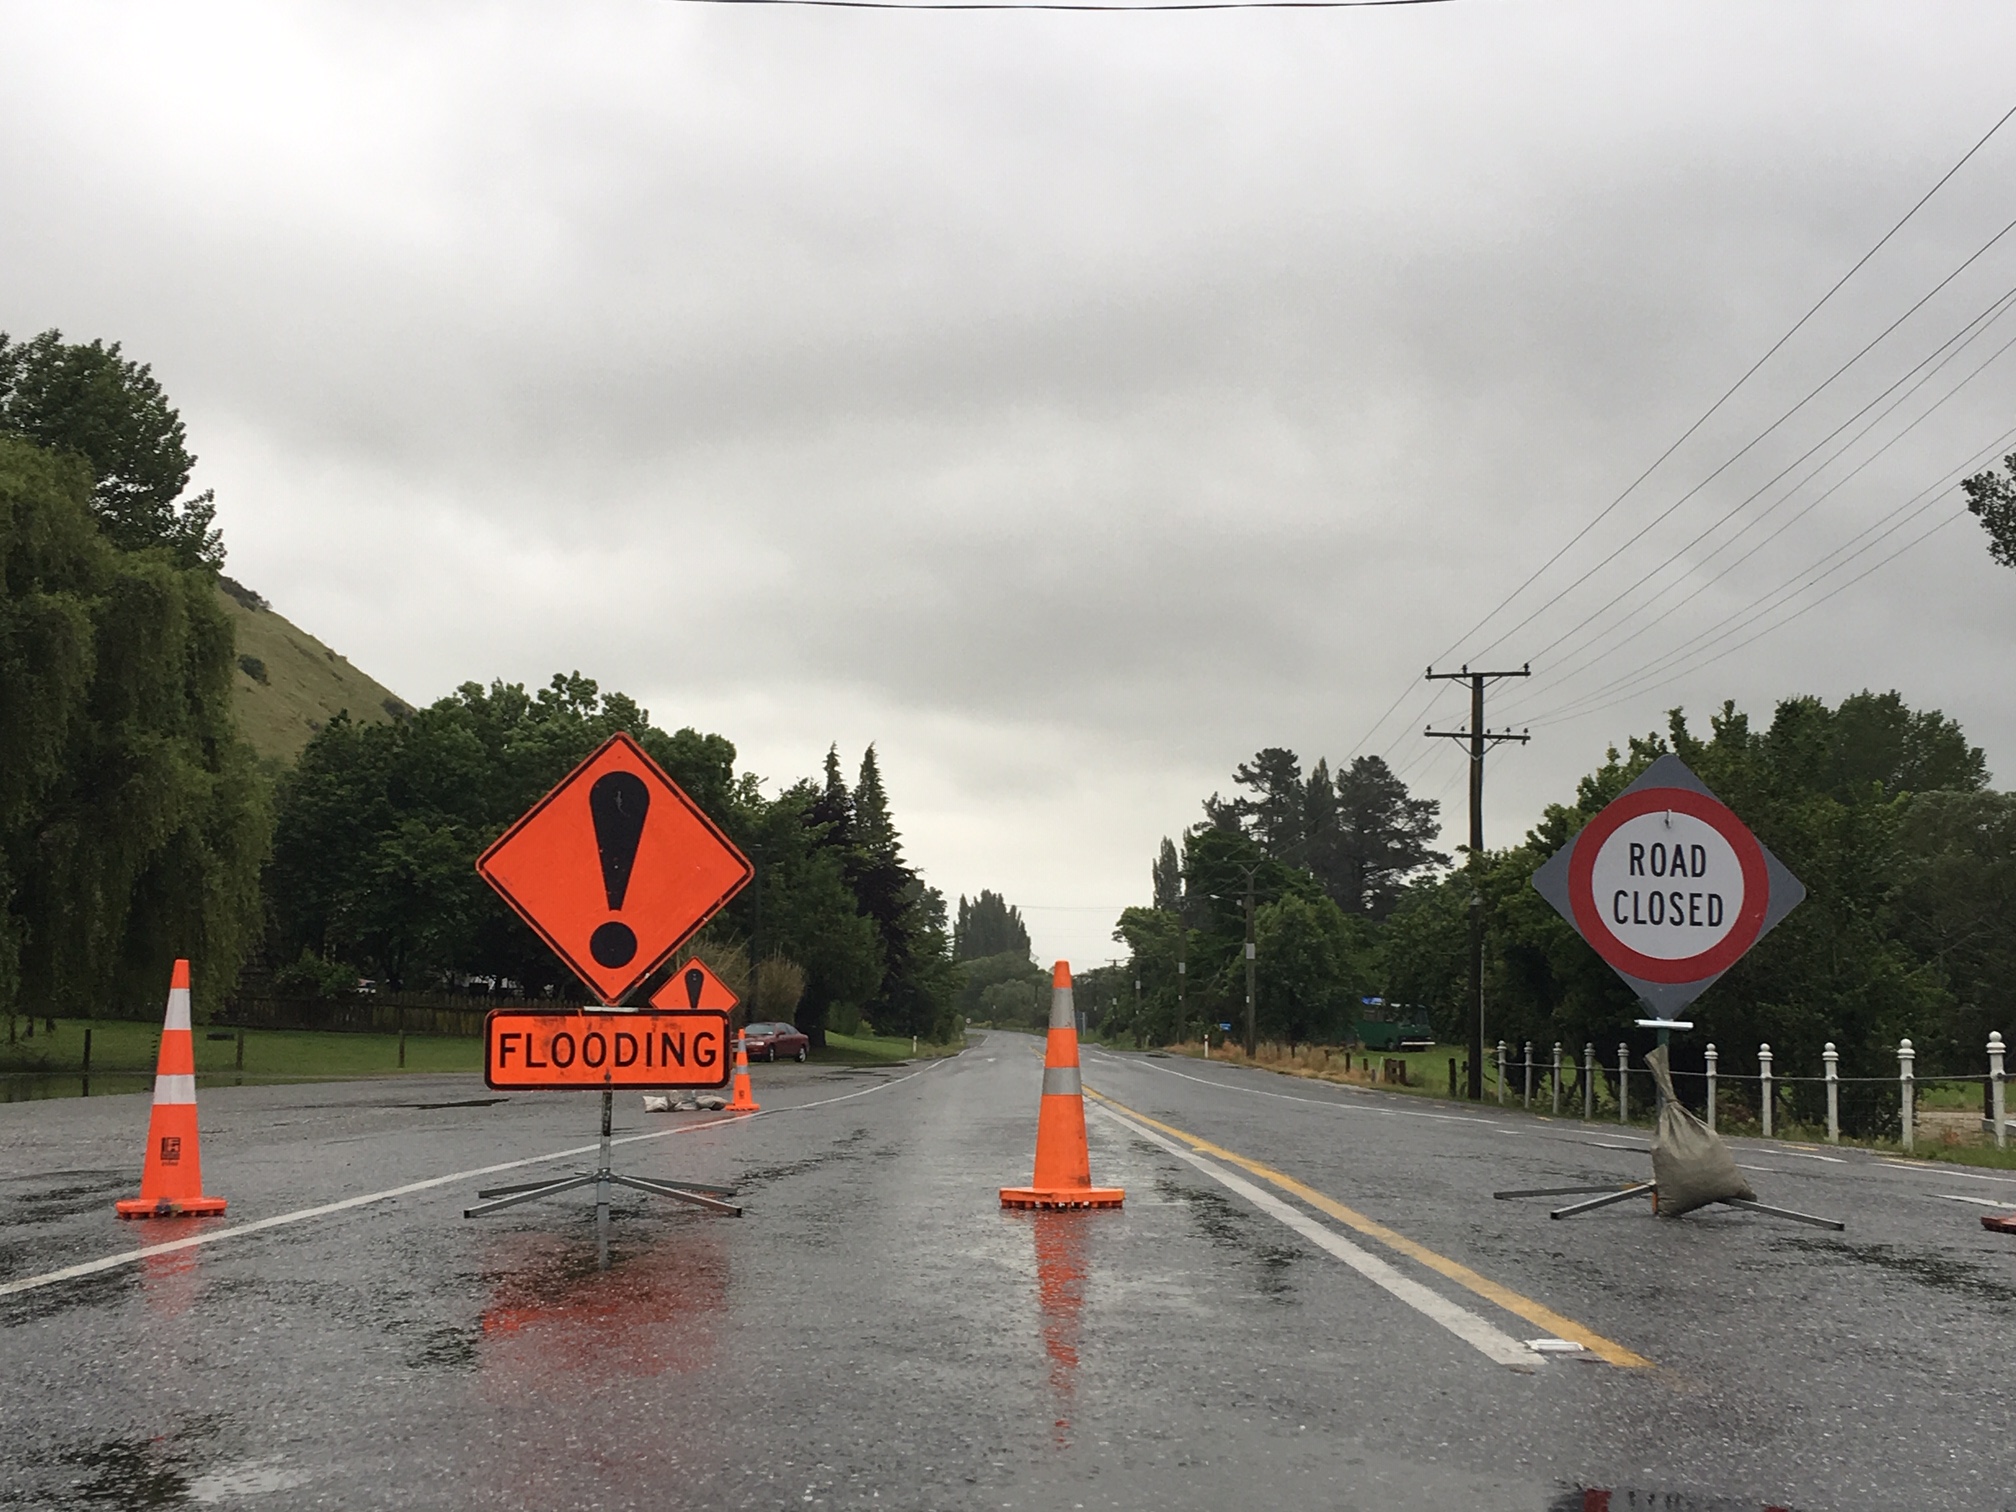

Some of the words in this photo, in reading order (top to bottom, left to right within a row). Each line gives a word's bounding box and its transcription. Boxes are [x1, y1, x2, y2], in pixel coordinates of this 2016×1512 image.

[1629, 842, 1706, 878] ROAD
[1613, 890, 1723, 927] CLOSED
[499, 1032, 717, 1069] FLOODING
